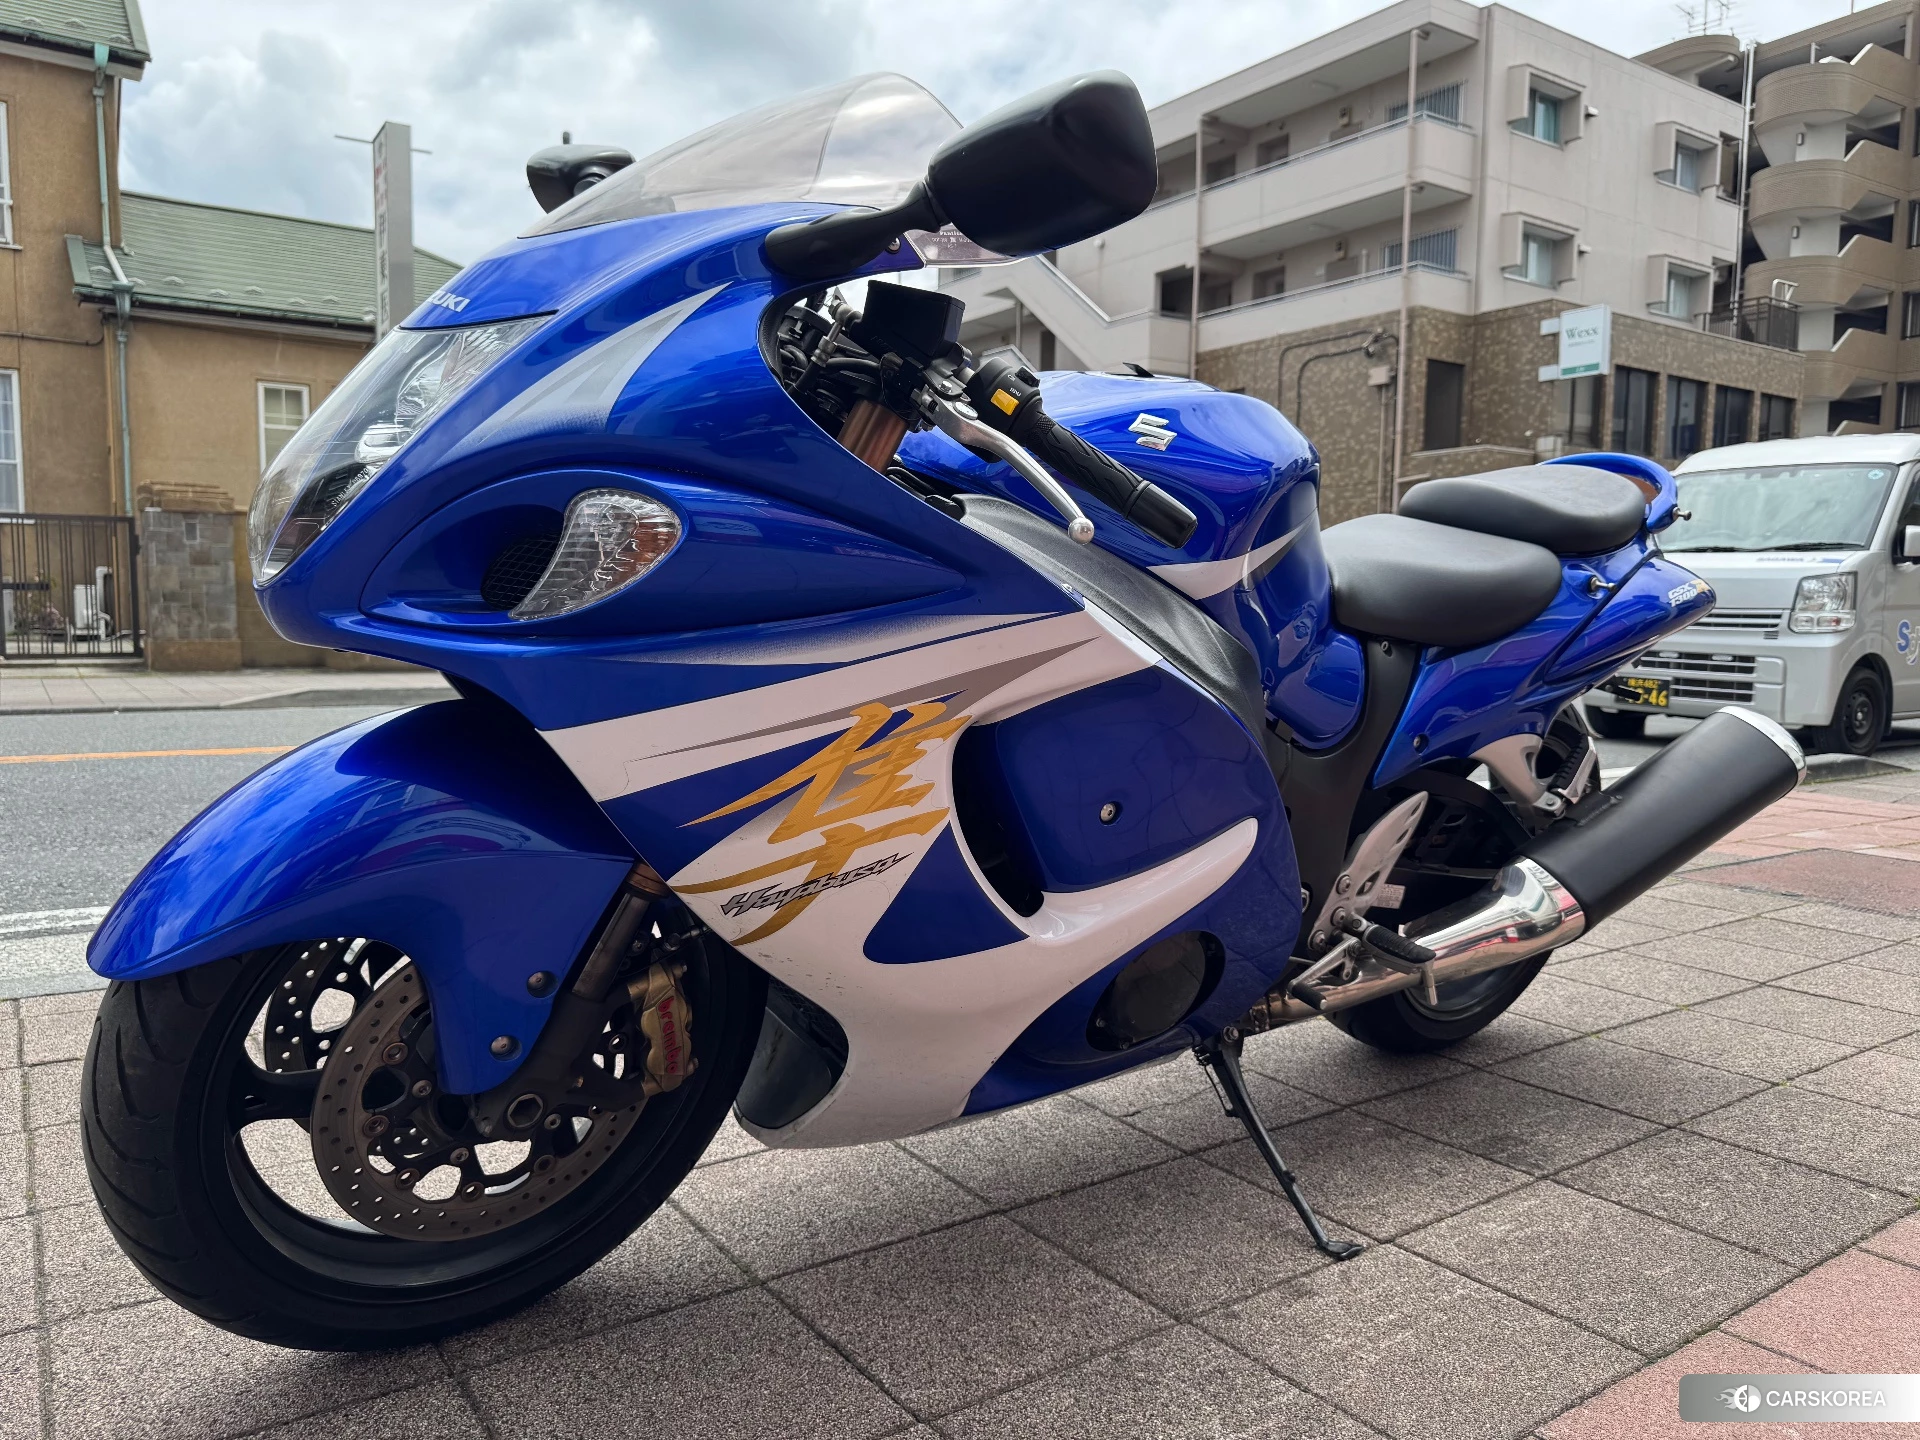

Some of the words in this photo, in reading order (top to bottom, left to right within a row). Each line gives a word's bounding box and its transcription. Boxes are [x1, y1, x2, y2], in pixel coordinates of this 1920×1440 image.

[429, 290, 471, 312] UKI
[1565, 326, 1599, 339] Wexx
[670, 702, 973, 946] 隼
[720, 852, 914, 917] Hayabusa
[658, 996, 682, 1074] brembo
